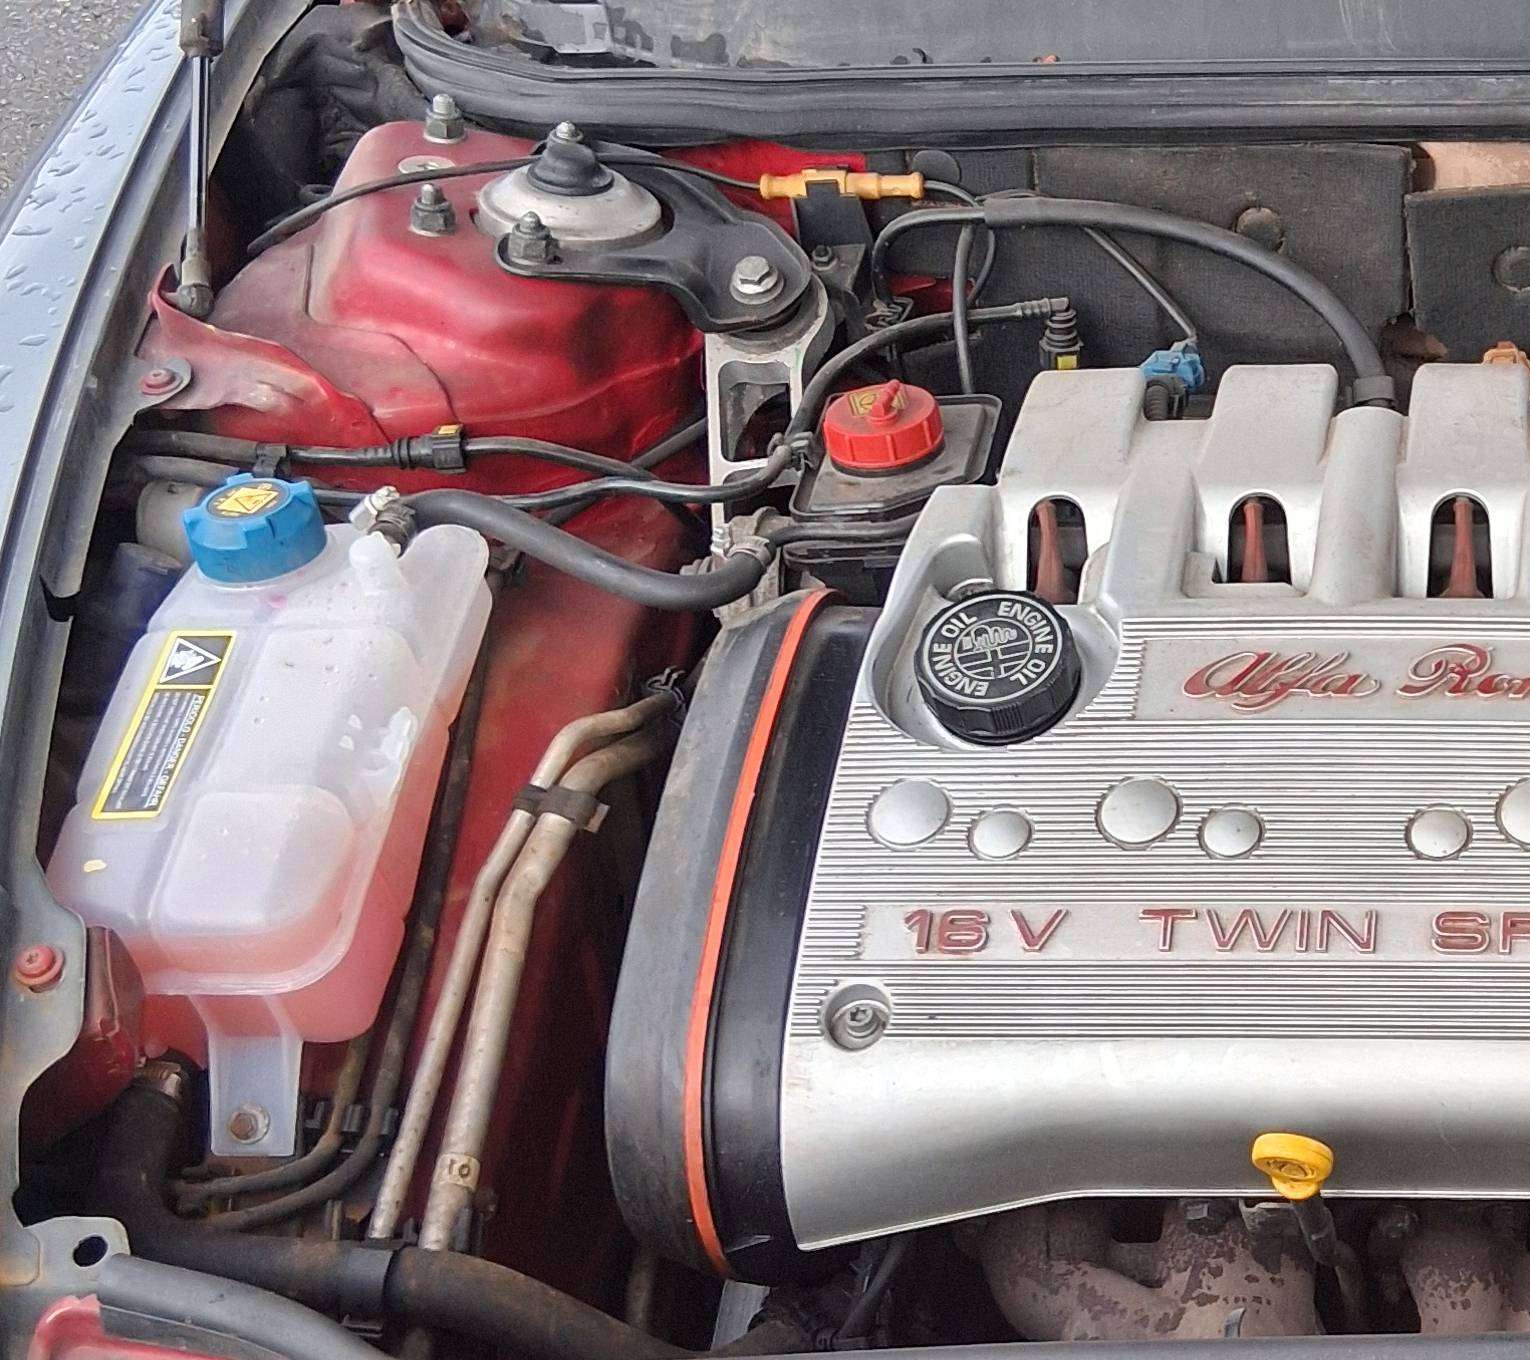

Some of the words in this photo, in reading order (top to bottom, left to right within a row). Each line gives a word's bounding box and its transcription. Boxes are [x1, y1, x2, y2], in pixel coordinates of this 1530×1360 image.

[941, 610, 978, 639] OIL
[997, 601, 1054, 654] ENGINE
[932, 642, 989, 697] ENGINE
[1010, 659, 1046, 686] OIL
[1181, 649, 1381, 715] Alfa
[1139, 908, 1377, 956] TWIN
